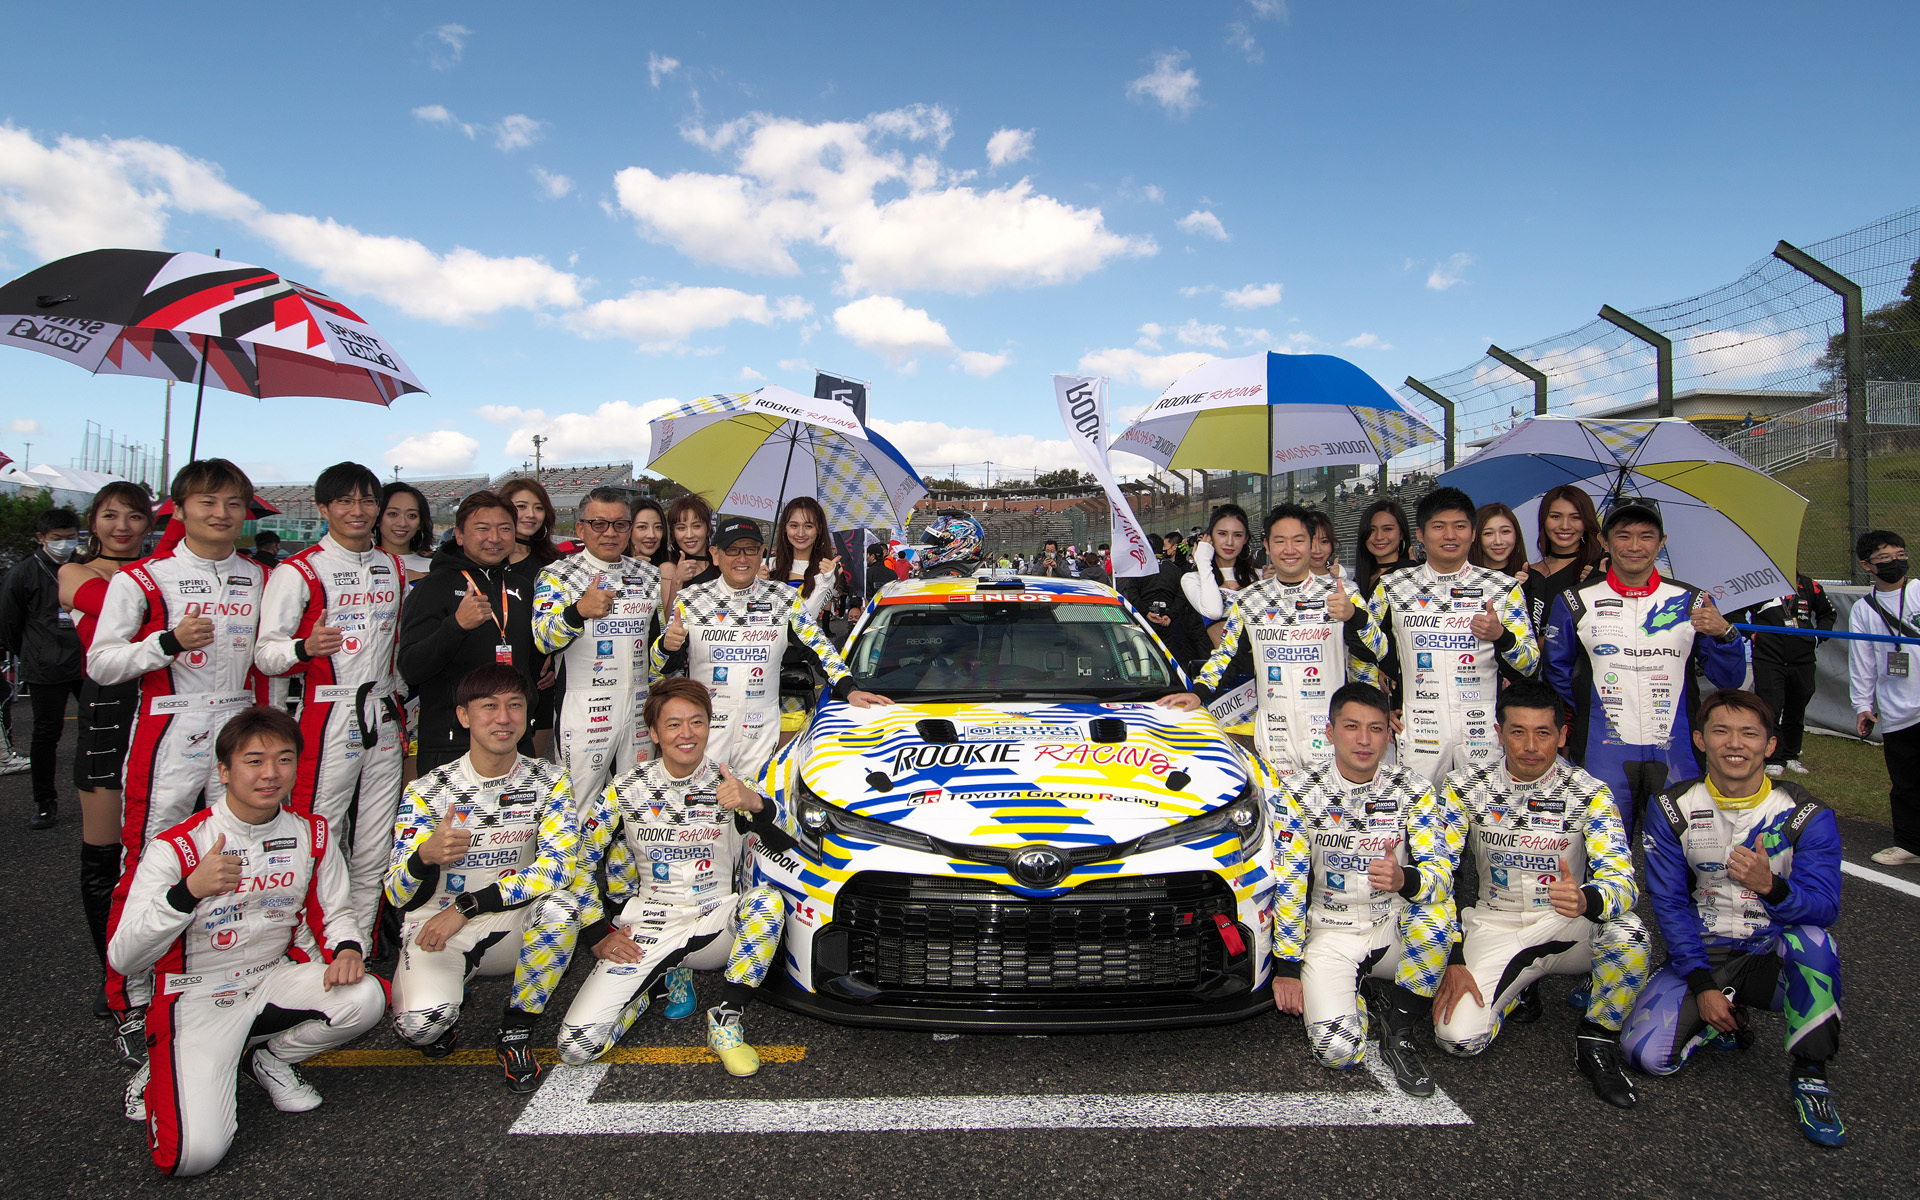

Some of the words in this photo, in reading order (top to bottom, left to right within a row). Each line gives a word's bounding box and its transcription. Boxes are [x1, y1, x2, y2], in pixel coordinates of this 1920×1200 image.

[325, 320, 382, 351] SPIRIT
[1155, 391, 1209, 410] ROOKIE
[1206, 384, 1263, 401] RACING
[755, 398, 804, 416] ROOKIE
[806, 411, 858, 429] RACING
[293, 559, 314, 580] sparco
[131, 568, 155, 592] sparco
[339, 591, 394, 606] DENSO
[969, 594, 1052, 602] ENEOS
[1563, 589, 1579, 611] sparco
[184, 602, 252, 617] DENSO
[623, 602, 652, 614] RACING
[335, 612, 365, 621] ADVICS
[1404, 615, 1442, 628] ROOKIE
[1445, 617, 1471, 629] RAC
[701, 629, 739, 642] ROOKIE
[742, 629, 779, 642] RACING
[906, 637, 942, 646] RECARO
[1256, 629, 1289, 641] ROOKIE
[1290, 628, 1332, 641] RACING
[1623, 648, 1681, 658] SUBARU
[588, 705, 612, 714] JTEKT
[1211, 693, 1245, 721] ROOKIE
[892, 744, 1025, 776] ROOKIE
[1034, 744, 1177, 775] RACING
[483, 777, 507, 789] ROOKIE
[671, 777, 692, 787] ROOKIE
[1514, 782, 1539, 791] ROOKIE
[947, 791, 1022, 801] TOYOTA
[1027, 790, 1094, 800] GAZOO
[1099, 792, 1159, 808] Racing
[1658, 795, 1679, 824] sparco
[1791, 803, 1819, 831] sparco
[315, 820, 325, 849] sparco
[489, 829, 534, 845] RACING
[636, 828, 676, 842] ROOKIE
[679, 828, 722, 843] RACING
[1480, 831, 1519, 848] ROOKIE
[1520, 836, 1571, 851] RACING
[173, 836, 197, 868] sparco
[222, 849, 248, 857] PIRIT
[467, 850, 518, 861] OGURA
[664, 847, 710, 855] OGURA
[664, 853, 711, 861] CLUTCH
[467, 857, 517, 867] CLUTCH
[1505, 854, 1556, 863] OGURA
[1503, 861, 1557, 871] CLUTCH
[234, 871, 295, 894] ENSO
[795, 914, 813, 928] Kawasaki
[245, 957, 280, 976] S.KOHNO
[169, 976, 202, 987] sparco
